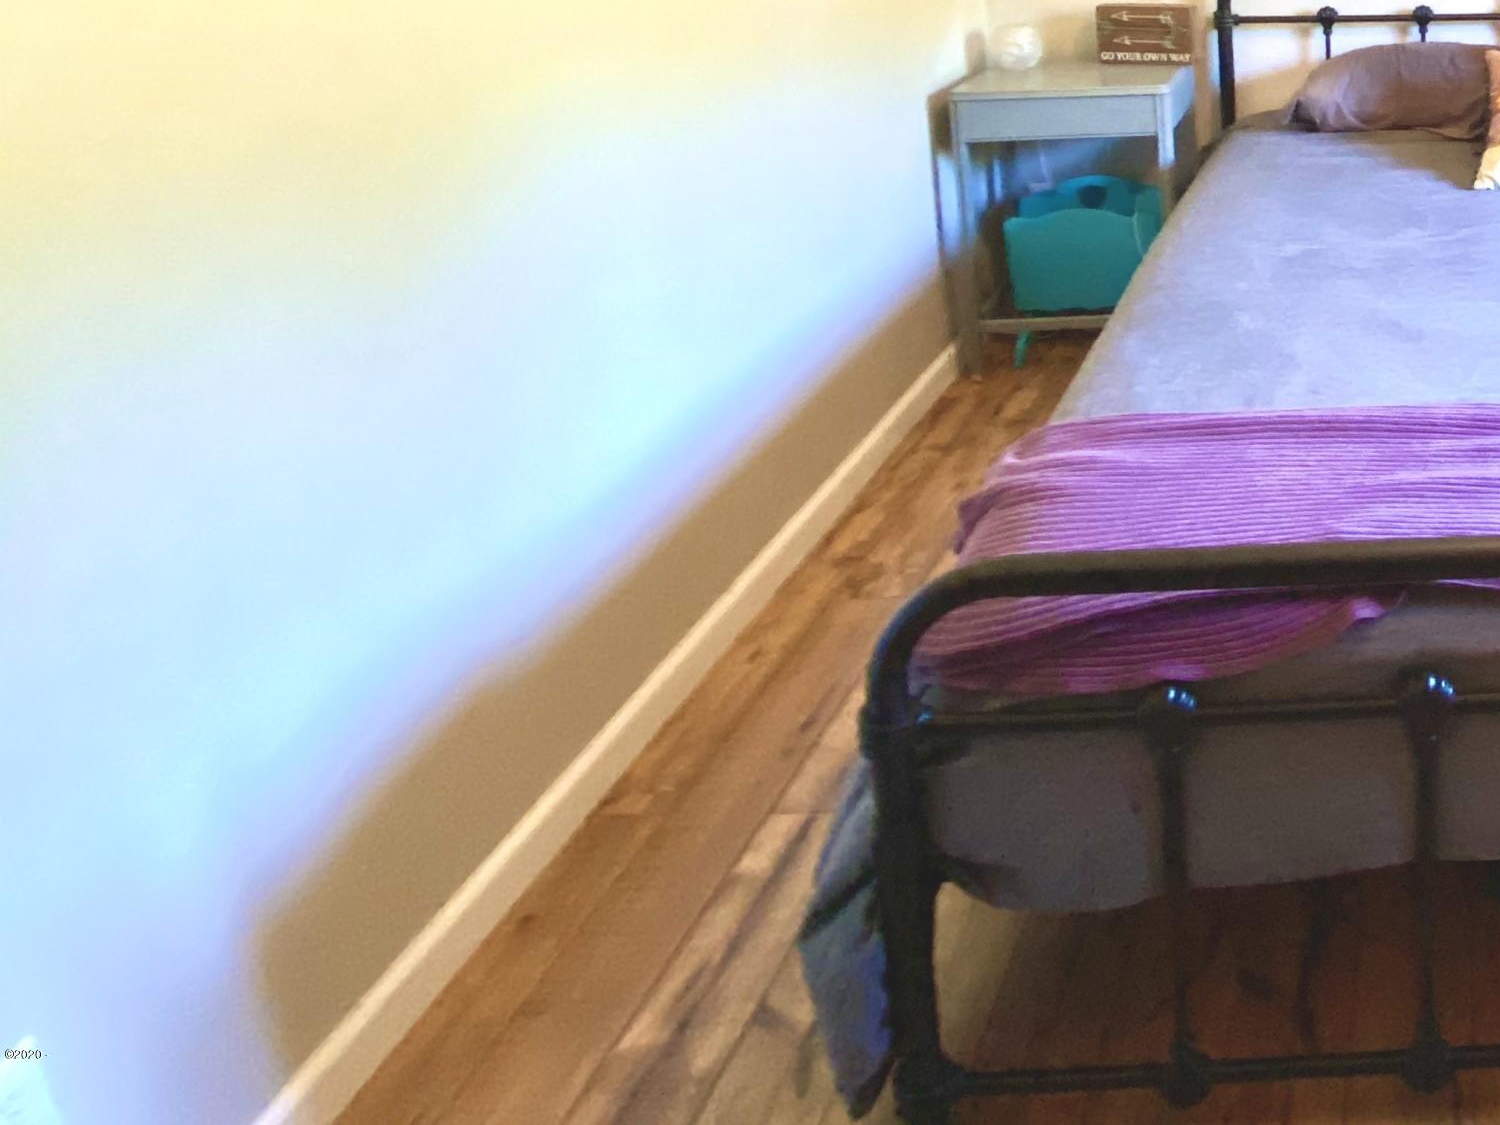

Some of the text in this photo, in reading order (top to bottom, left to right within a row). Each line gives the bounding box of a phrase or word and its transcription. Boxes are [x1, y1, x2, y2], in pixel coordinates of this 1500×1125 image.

[1101, 51, 1191, 62] GO YOUR OWN WAY
